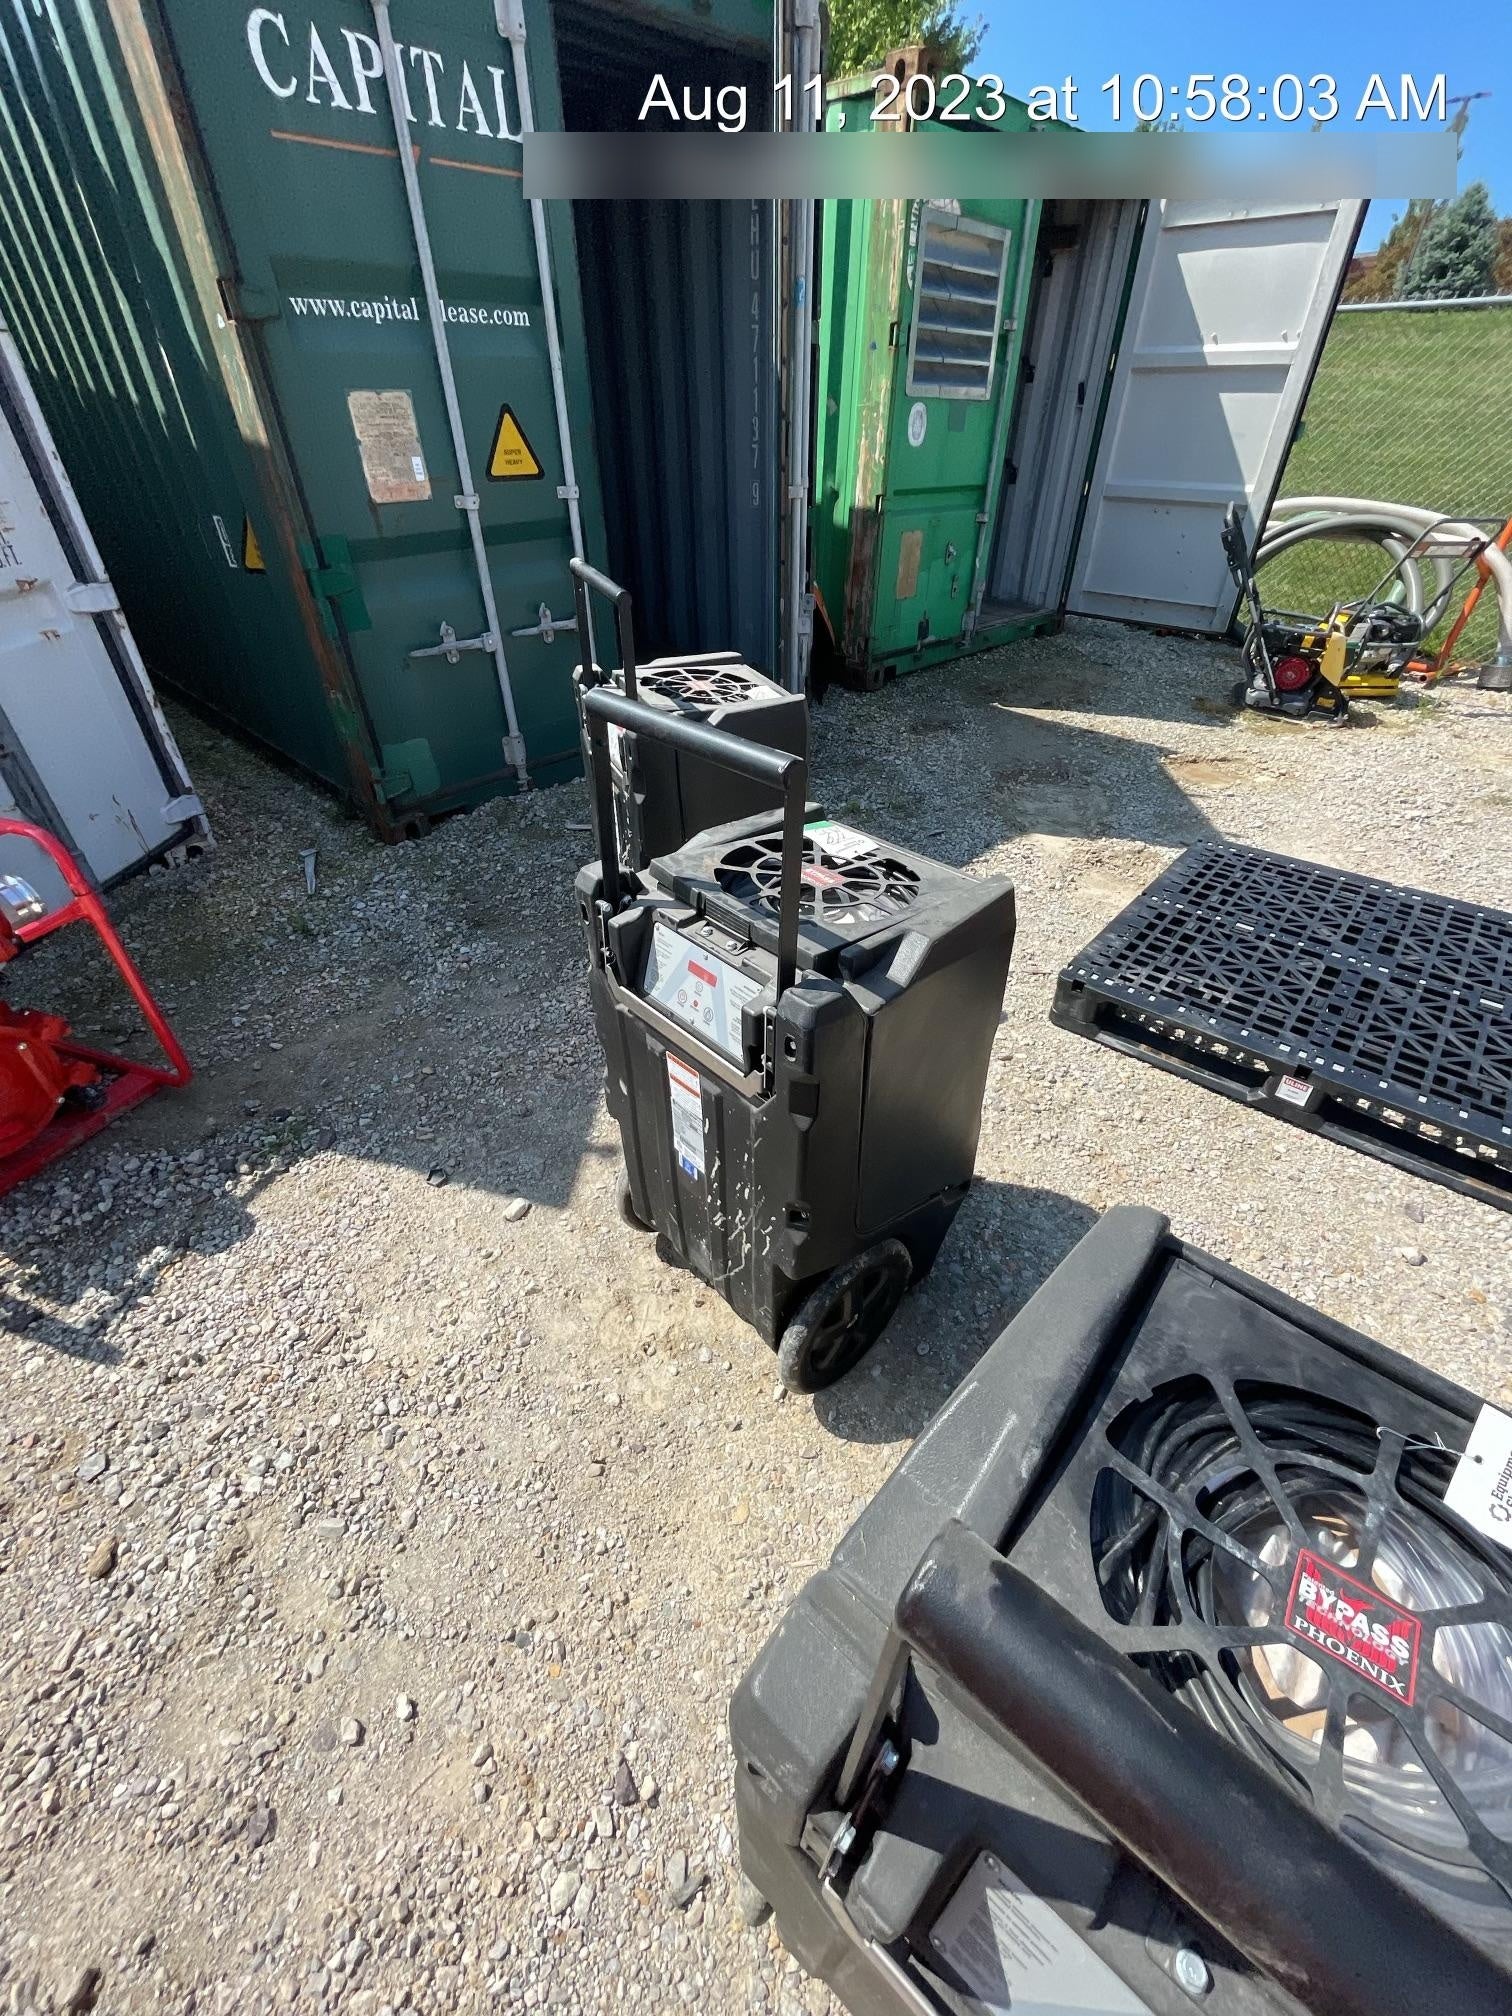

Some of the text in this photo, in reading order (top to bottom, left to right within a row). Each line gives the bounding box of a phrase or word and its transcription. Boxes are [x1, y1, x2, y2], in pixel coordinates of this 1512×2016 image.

[247, 8, 525, 143] CAPITAL
[1491, 1449, 1512, 1501] Equipm
[1294, 1615, 1406, 1697] PHOENIX
[1299, 1576, 1410, 1661] BYPASS
